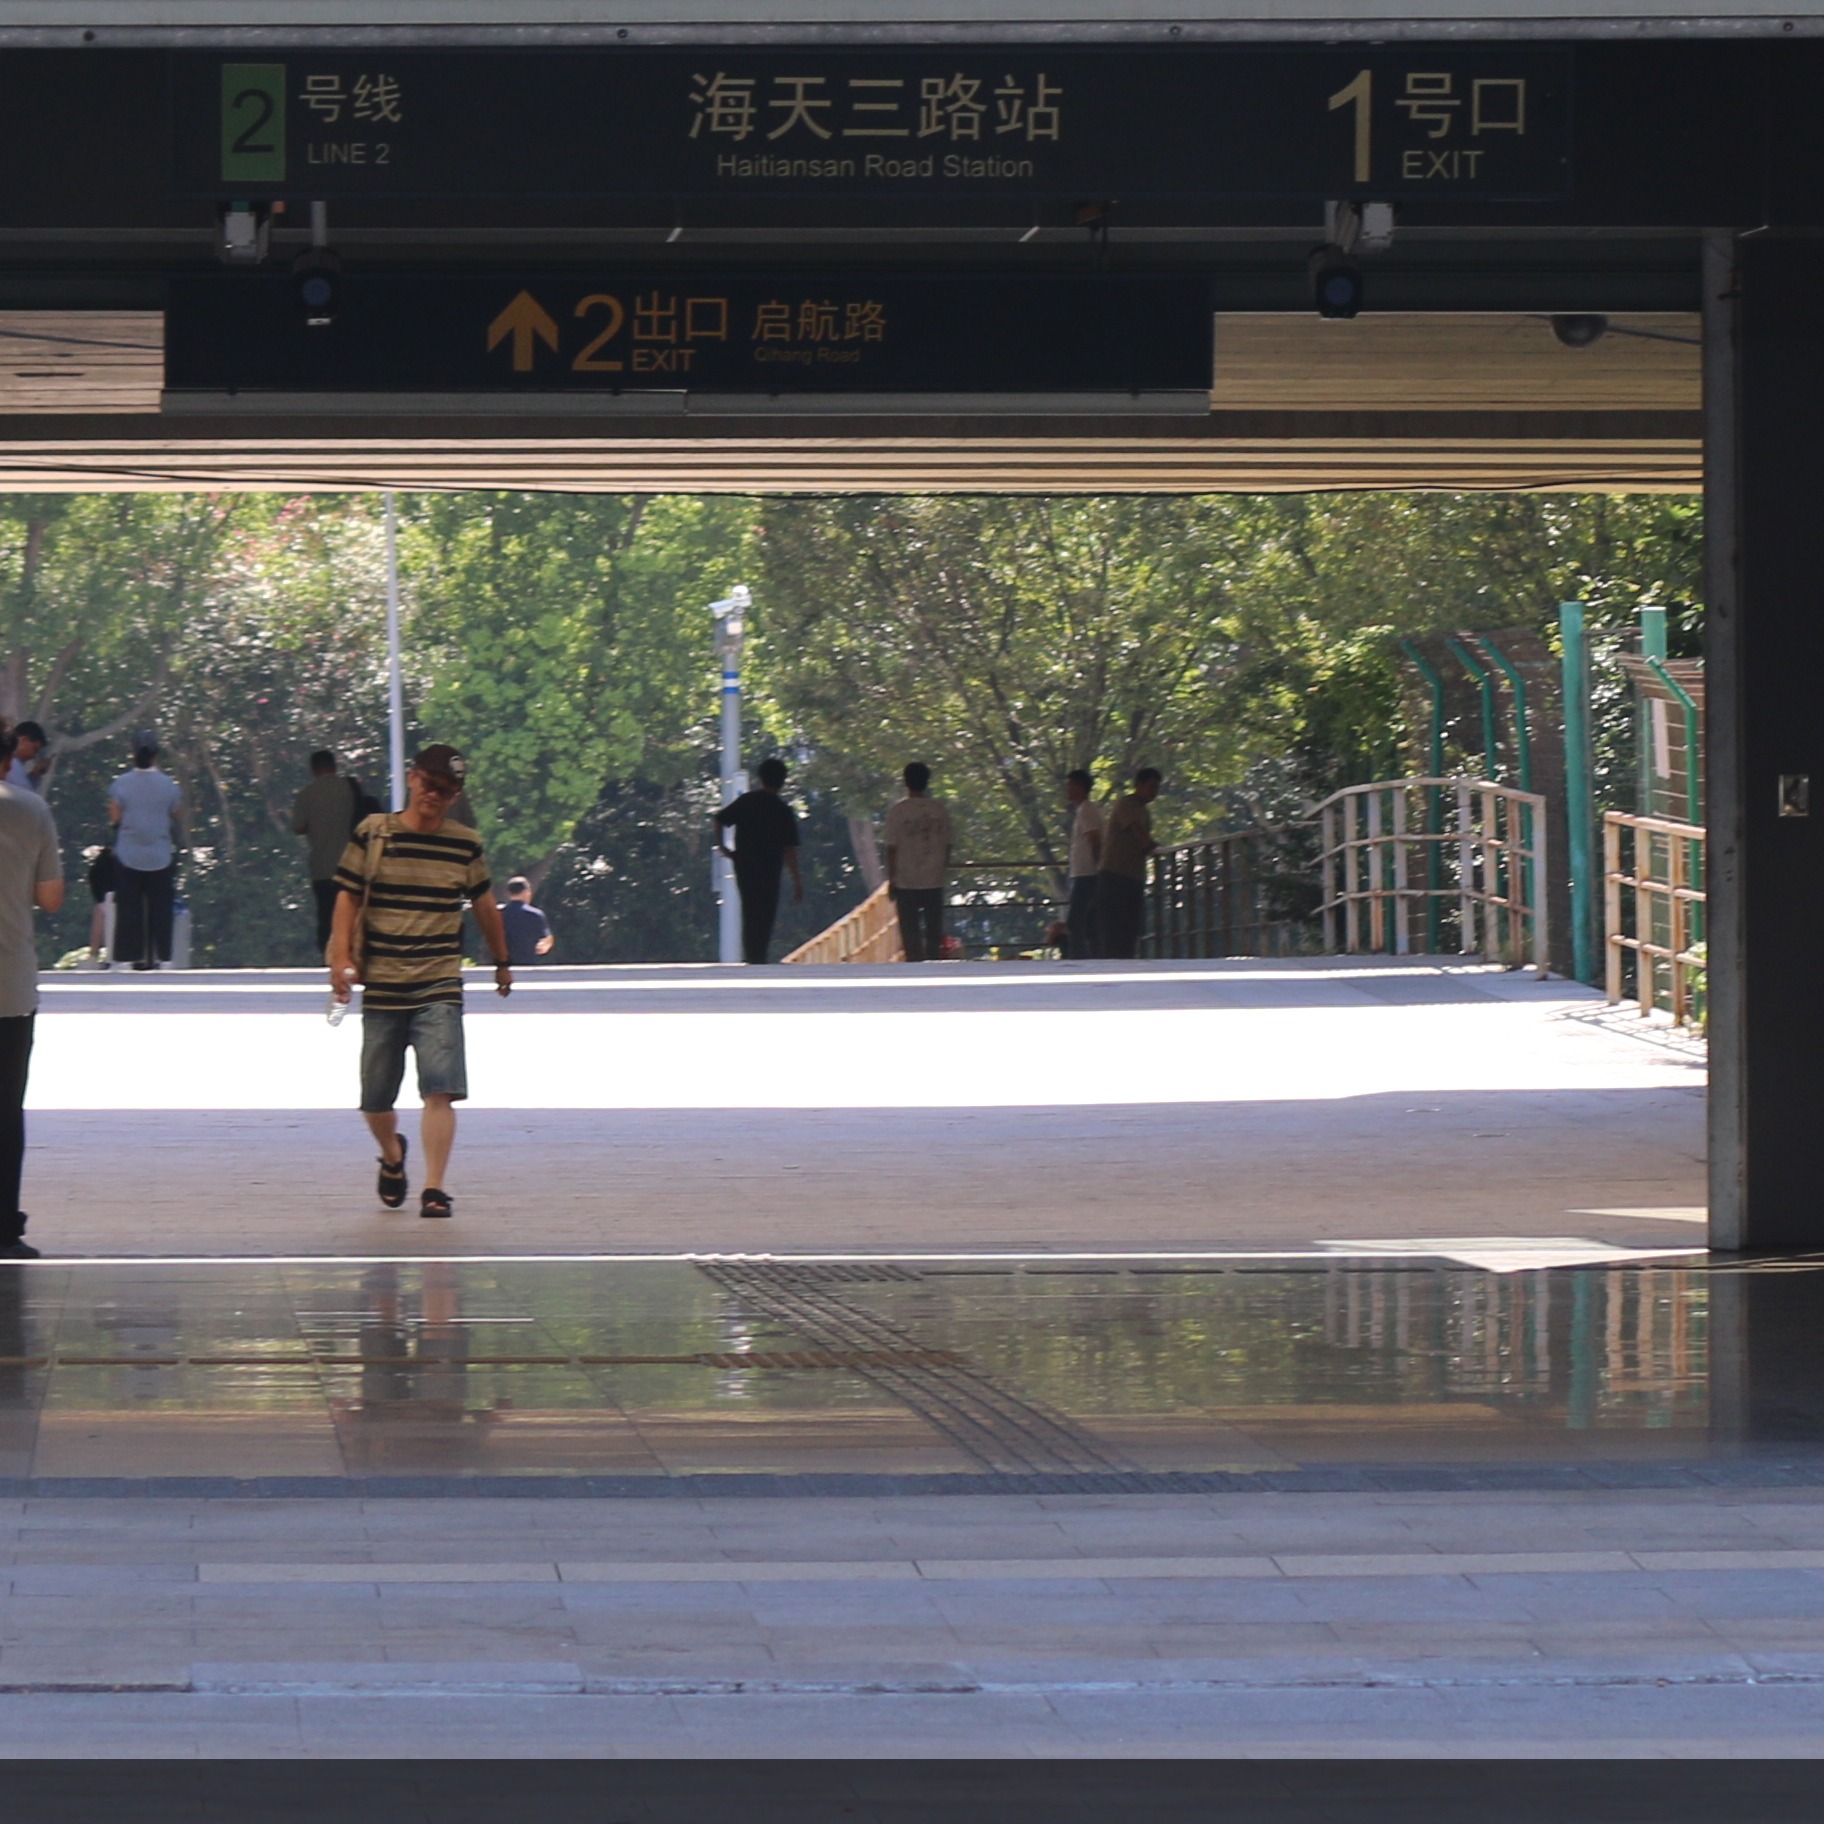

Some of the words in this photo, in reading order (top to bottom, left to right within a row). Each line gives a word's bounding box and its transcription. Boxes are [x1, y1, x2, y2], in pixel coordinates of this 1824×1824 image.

[231, 88, 276, 154] 2
[298, 74, 403, 124] 号线
[687, 71, 1065, 142] 海天三路站
[1327, 68, 1373, 183] 1
[1394, 72, 1526, 139] 号口
[307, 143, 367, 165] LINE
[375, 143, 391, 165] 2
[716, 154, 856, 178] Haitiansan
[865, 154, 934, 178] Road
[942, 154, 1035, 178] Station
[1401, 150, 1485, 180] EXIT
[571, 293, 624, 373] 2
[631, 290, 729, 344] 出口
[750, 298, 888, 343] 启航路
[631, 348, 697, 373] EXIT
[816, 346, 862, 364] Road
